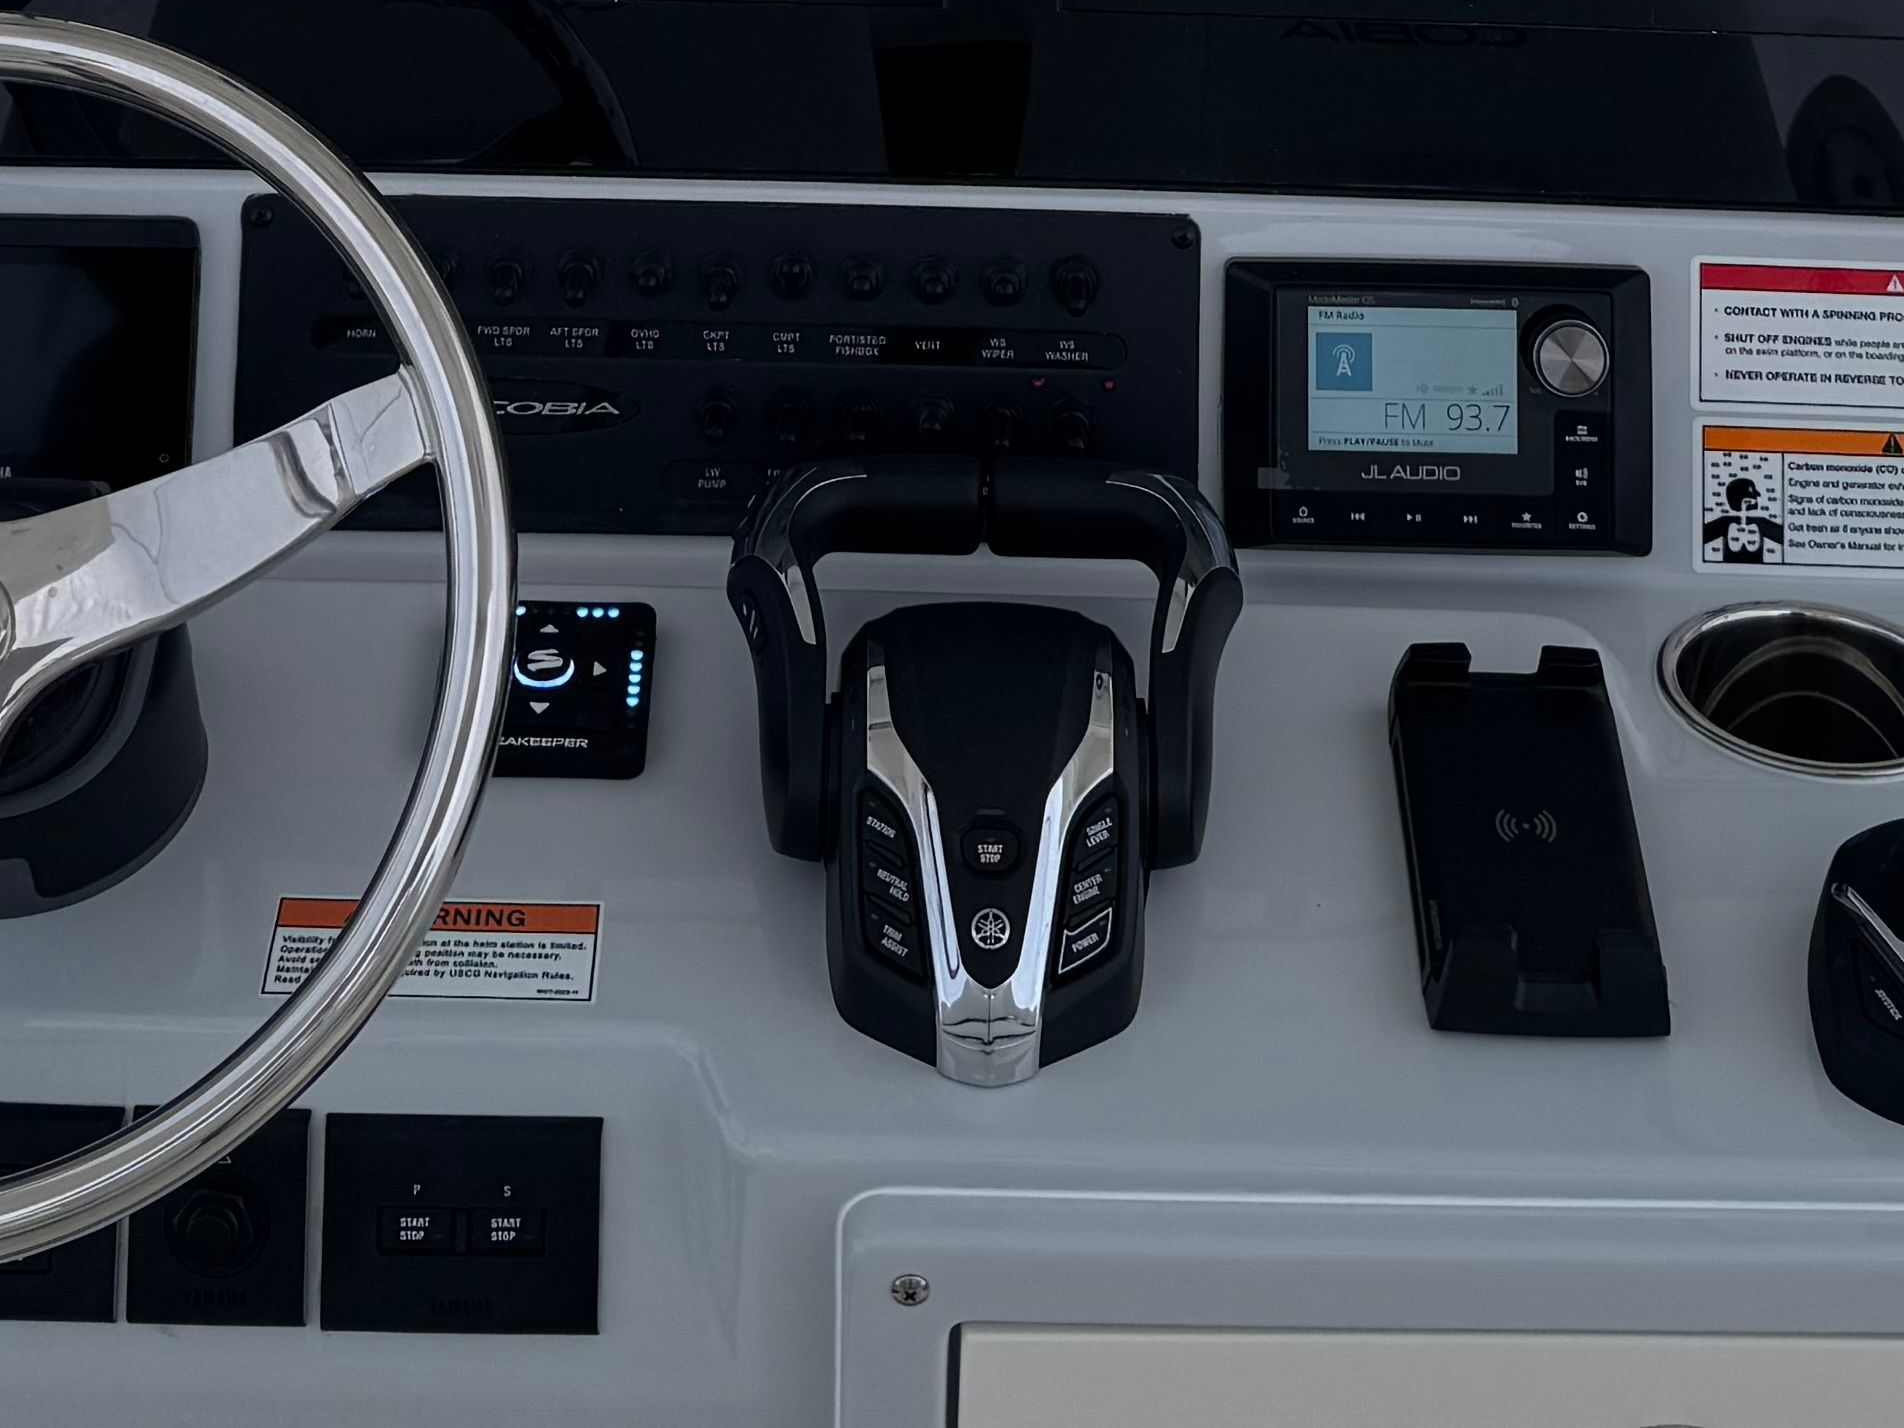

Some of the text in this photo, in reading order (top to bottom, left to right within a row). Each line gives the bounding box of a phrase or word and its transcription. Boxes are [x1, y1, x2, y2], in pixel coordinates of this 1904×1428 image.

[1724, 305, 1777, 318] CONTACT
[1780, 308, 1809, 319] WITH
[1812, 308, 1820, 319] A
[346, 329, 377, 339] HORN
[477, 326, 500, 336] FWD
[549, 327, 570, 337] AFT
[1384, 402, 1511, 432] FM 93.7
[1361, 464, 1462, 481] JL AUDIO
[500, 736, 589, 748] AKEEPER
[977, 844, 1004, 854] START
[980, 854, 1001, 863] STOP
[433, 908, 527, 927] RNING
[412, 1184, 421, 1195] P
[504, 1185, 512, 1197] S
[400, 1217, 430, 1228] START
[490, 1217, 522, 1229] START
[399, 1230, 425, 1241] STOP
[490, 1231, 516, 1241] STOP
